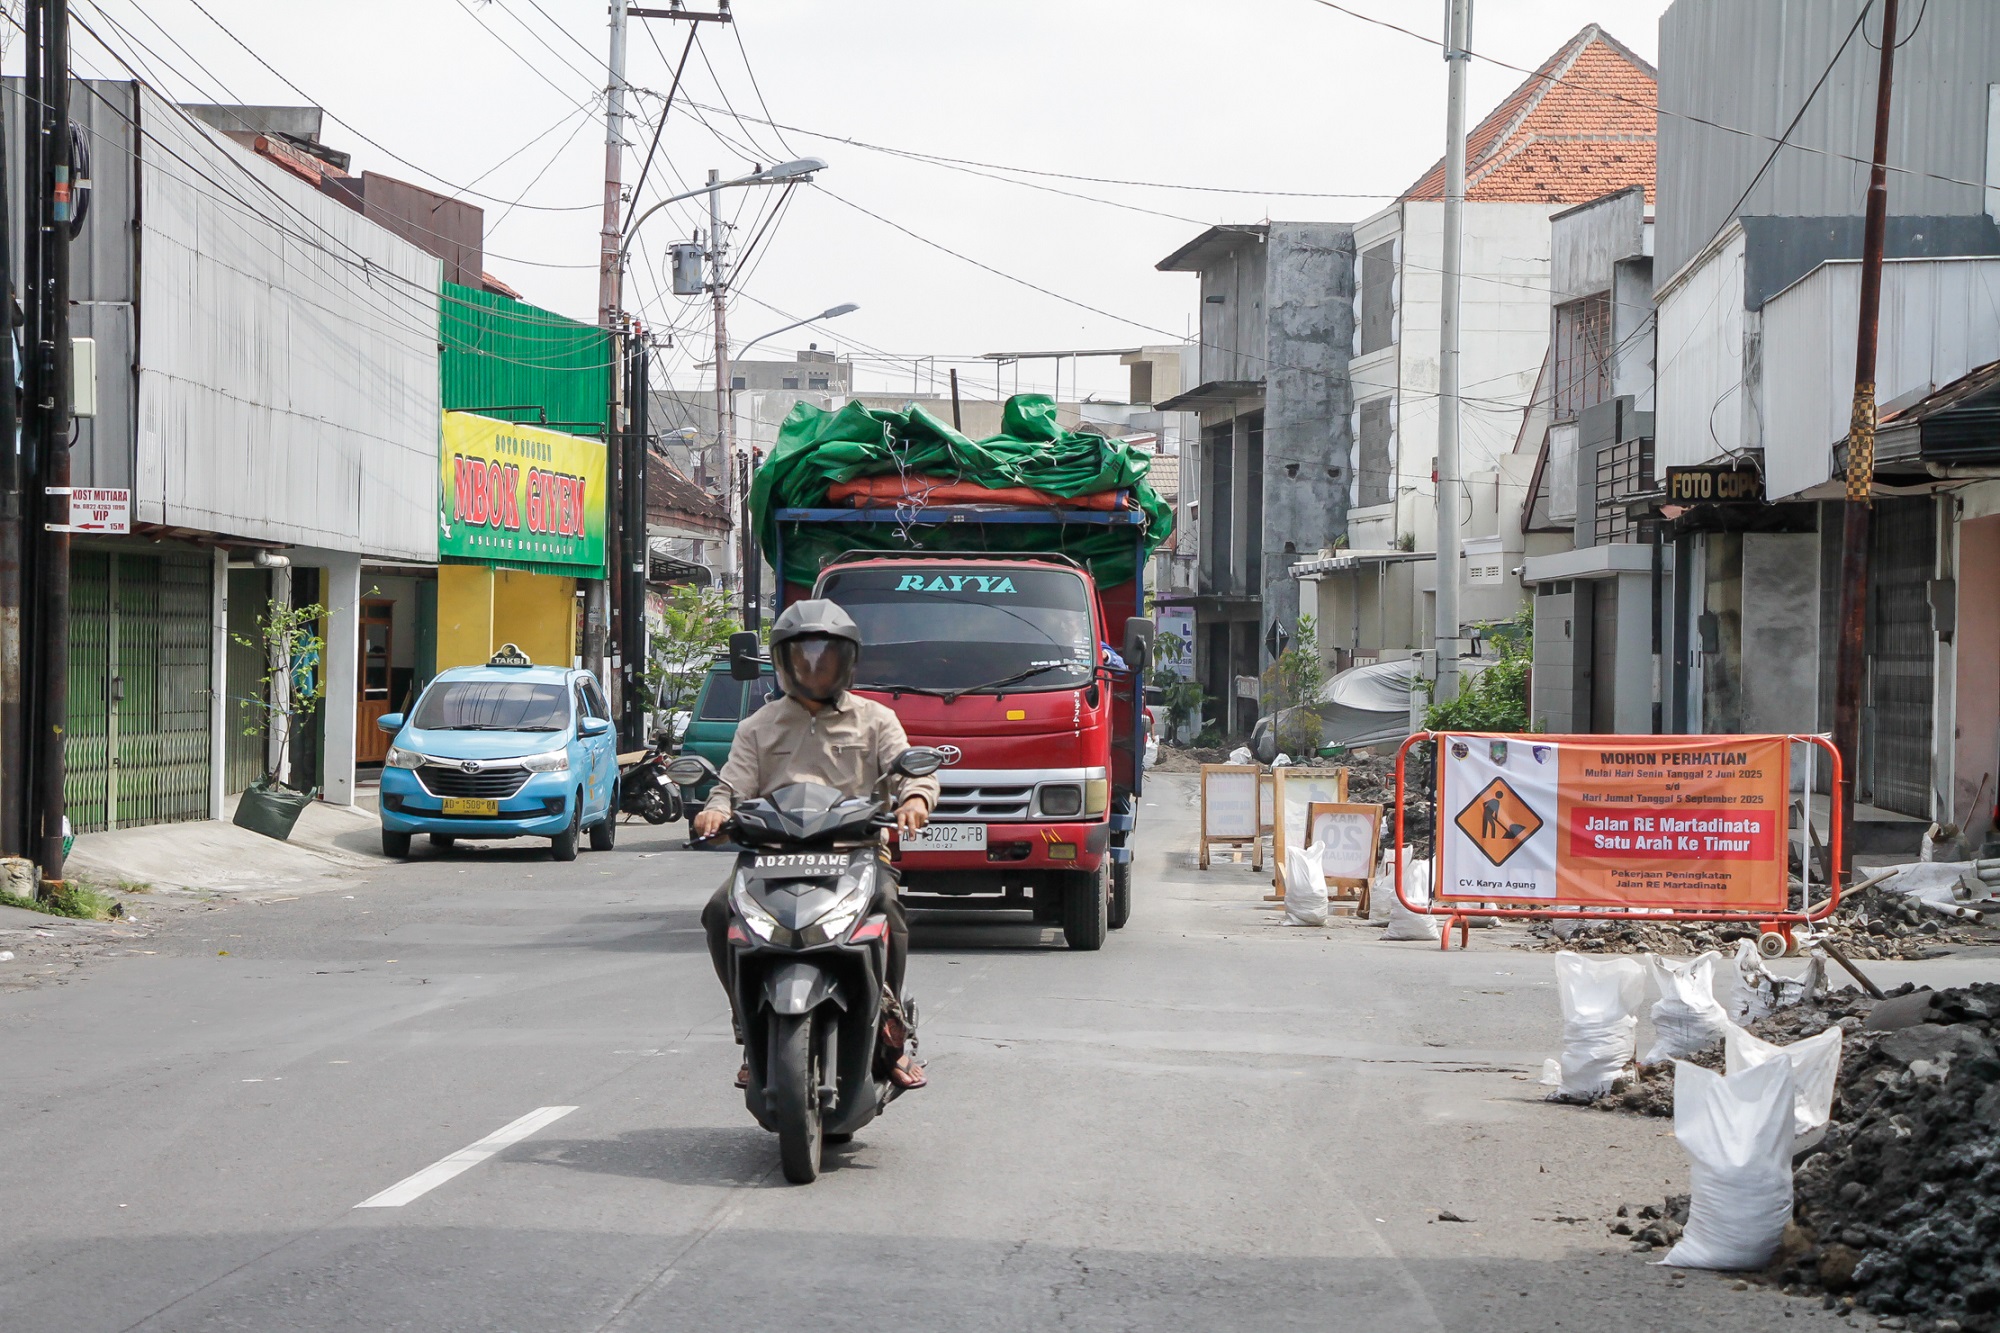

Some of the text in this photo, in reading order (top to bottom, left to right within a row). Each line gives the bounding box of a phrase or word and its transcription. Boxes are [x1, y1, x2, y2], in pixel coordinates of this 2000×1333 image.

[496, 434, 518, 456] SOTO
[1672, 472, 1760, 499] FOTO COPY
[73, 489, 127, 501] KOST MUTIARA
[454, 453, 586, 540] MBOK GIYEM
[93, 511, 109, 520] VIP
[470, 535, 512, 549] ASLINE
[895, 574, 1018, 594] RAYYA
[494, 657, 524, 665] TAKSI
[1600, 752, 1747, 766] MOHON PERHATIAN
[1585, 768, 1762, 780] Mulai Hari Senin Tanggal 2 Juni 2025
[1666, 782, 1680, 791] s/d
[444, 799, 454, 808] AD
[1582, 794, 1764, 805] Hari Jumat Tanggal 5 September 2025
[1585, 816, 1760, 834] Jalan RE Martadinata
[926, 826, 958, 842] 9202
[967, 826, 983, 842] FB
[1594, 834, 1751, 852] Satu Arah Ke Timur
[1611, 870, 1732, 880] Pekerjaan Peningkatan
[1459, 878, 1536, 890] CV. Karya Agung
[1616, 880, 1643, 888] Jalan
[1664, 882, 1727, 890] Martadinata
